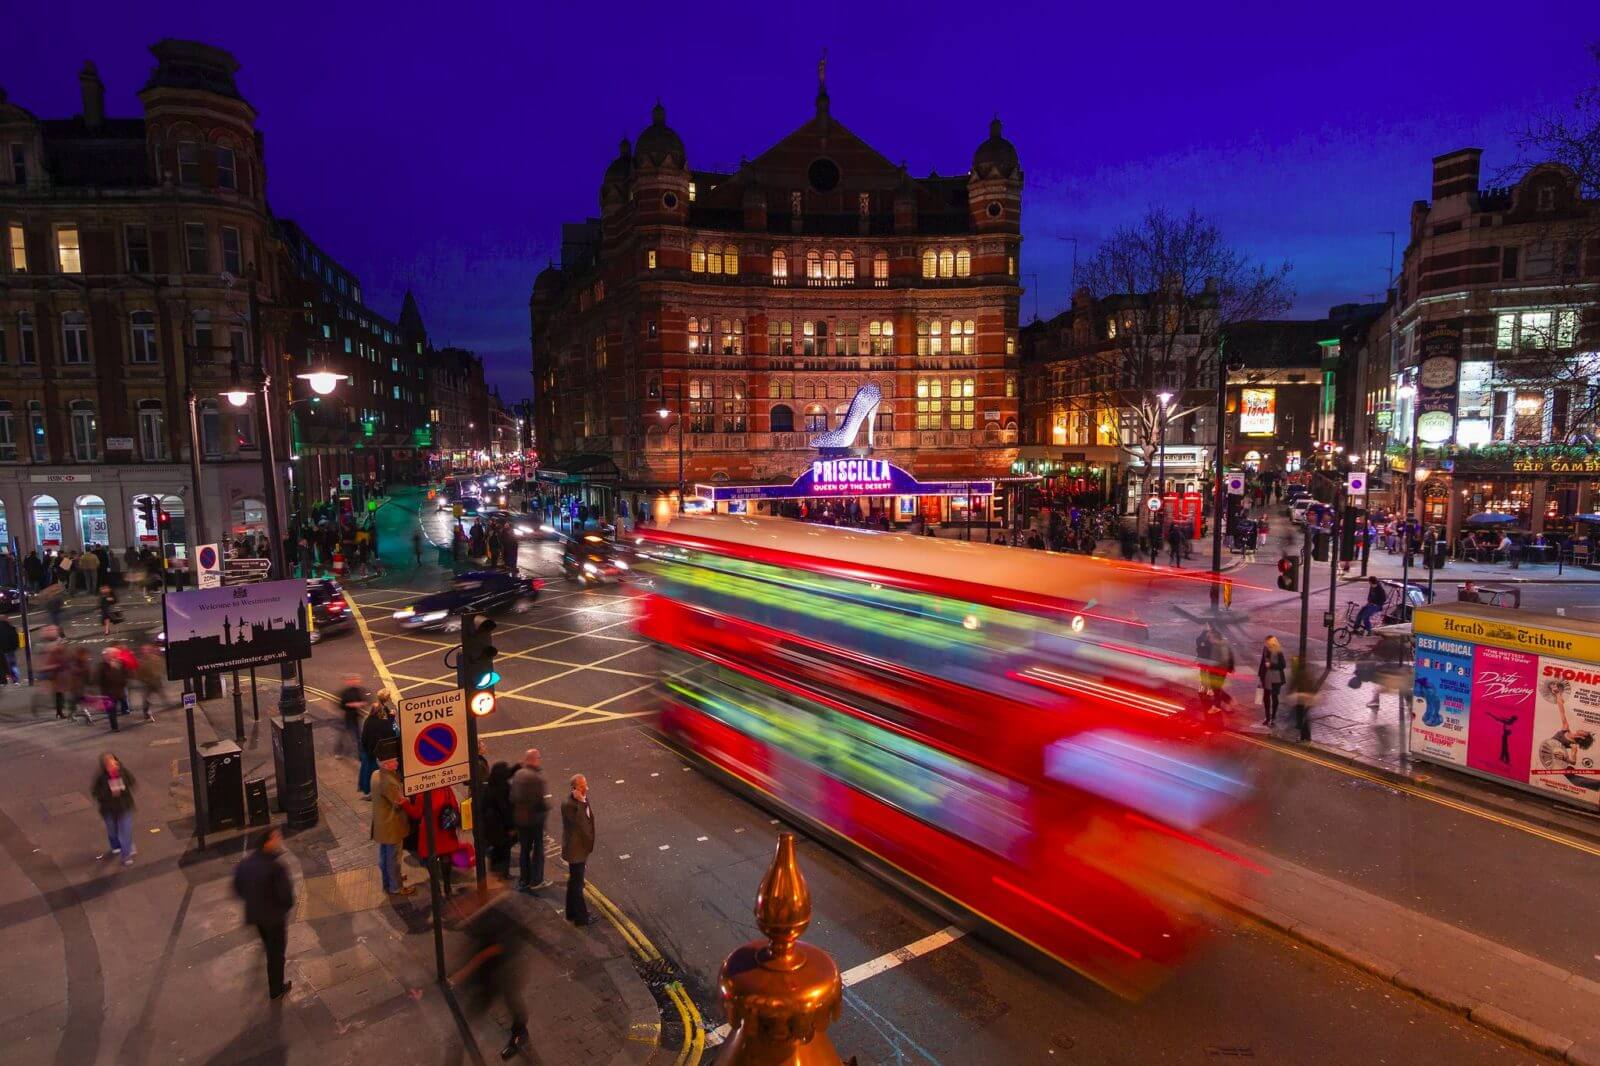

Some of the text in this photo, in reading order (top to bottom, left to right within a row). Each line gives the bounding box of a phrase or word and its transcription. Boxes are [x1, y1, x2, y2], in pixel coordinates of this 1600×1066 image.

[813, 460, 891, 482] PRISCILLA
[1513, 462, 1544, 472] THE
[48, 522, 60, 531] 30
[94, 522, 106, 530] 30
[199, 602, 230, 611] Welcome
[242, 596, 280, 606] Westminster
[1444, 618, 1572, 650] Herald Tribune
[1418, 638, 1472, 656] BEST MUSICAL
[1476, 672, 1522, 686] Dirty
[1543, 666, 1600, 685] STOMP
[405, 693, 461, 712] Controlled
[1482, 683, 1534, 704] Dancing
[415, 706, 454, 724] ZONE
[408, 782, 424, 793] 8.30
[441, 774, 456, 784] 6.30
